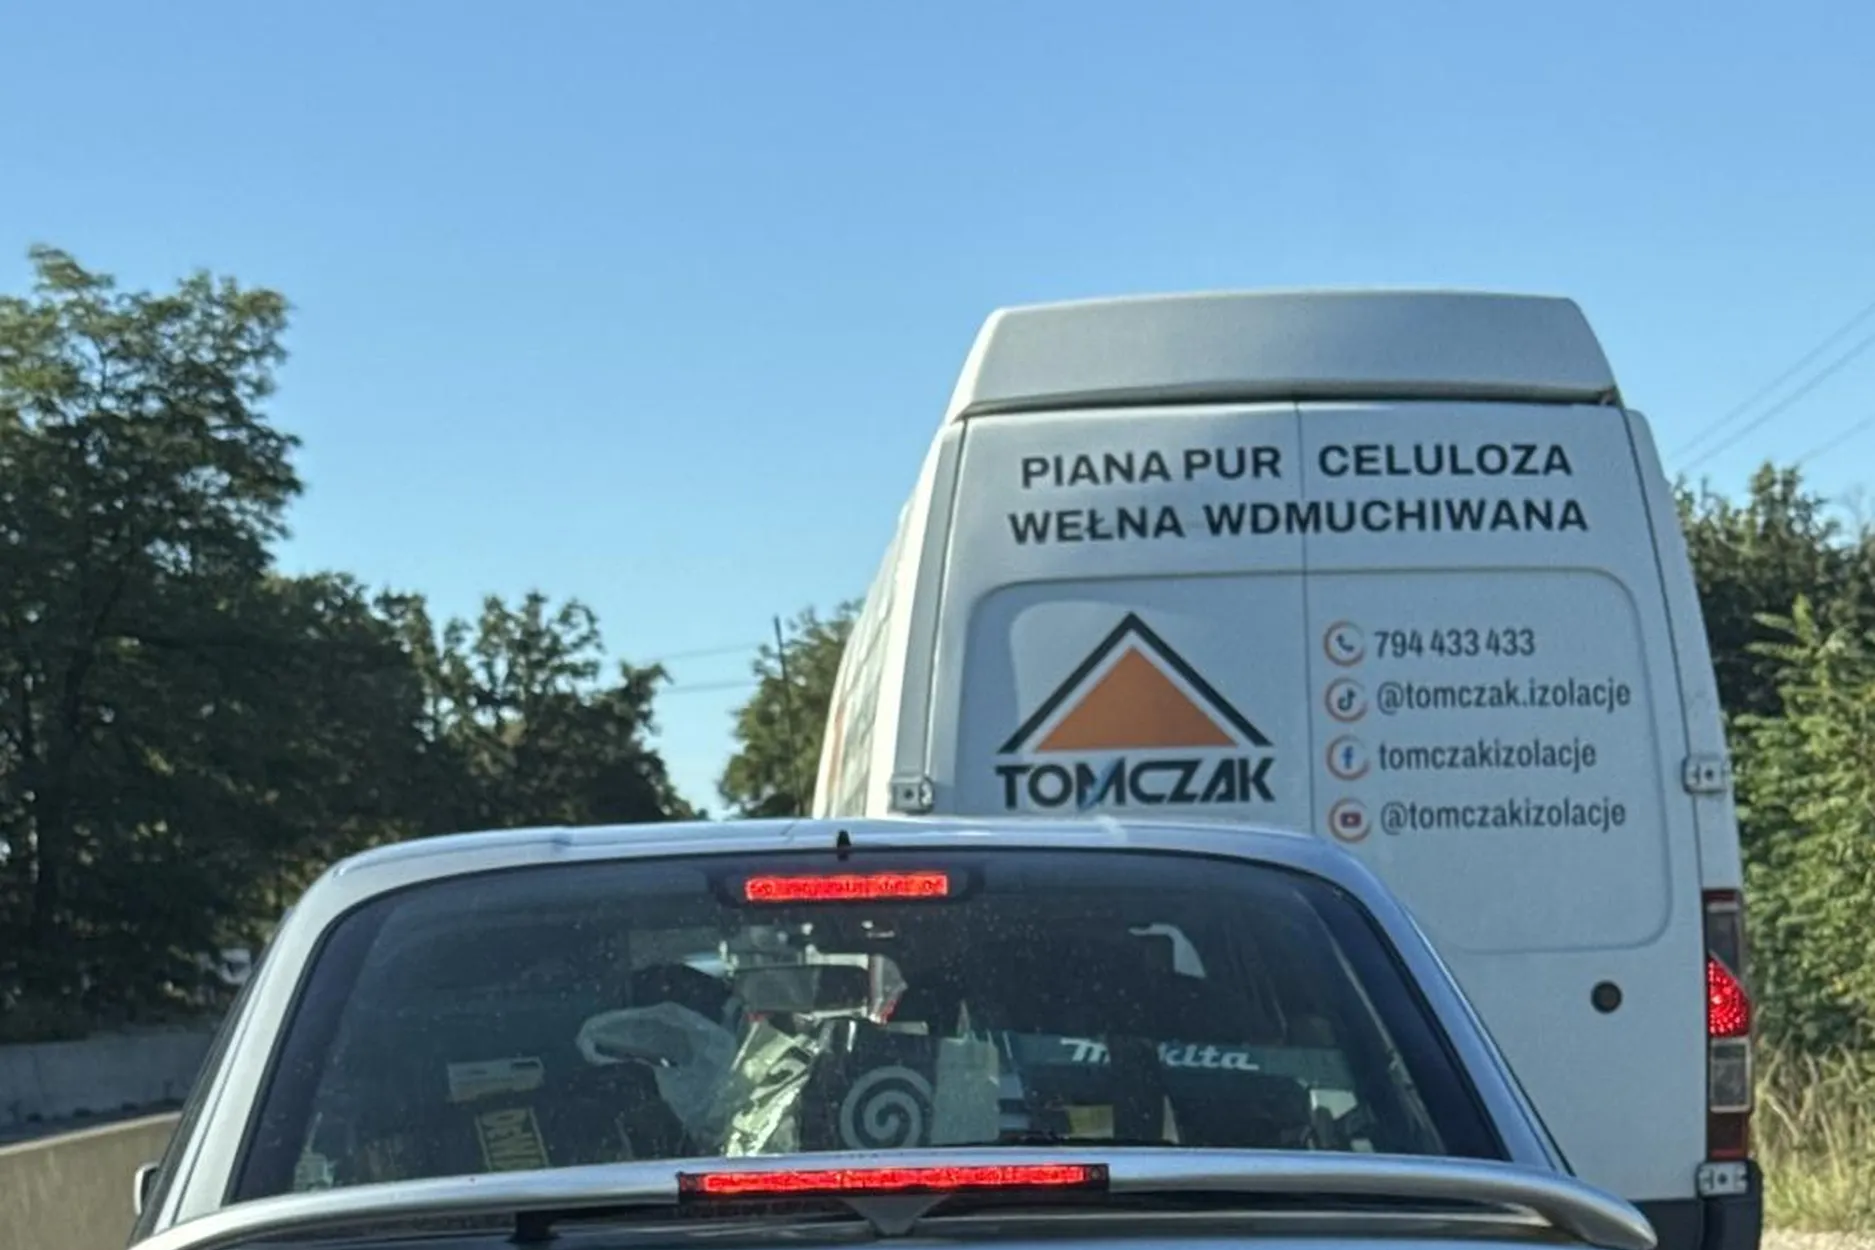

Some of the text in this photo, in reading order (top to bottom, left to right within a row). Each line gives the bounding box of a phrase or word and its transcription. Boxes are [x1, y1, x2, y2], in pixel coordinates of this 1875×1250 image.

[1020, 443, 1572, 488] PIANA PUR CELULOZA
[1009, 498, 1588, 545] WEŁNA WDMUCHIWANA
[1374, 627, 1535, 659] 794 433 433
[1376, 676, 1631, 716] @tomczak.izolacje
[1379, 737, 1597, 773] tomczakizolacje
[995, 757, 1276, 812] TOMCZAK
[1380, 797, 1626, 836] @tomczakizolacje
